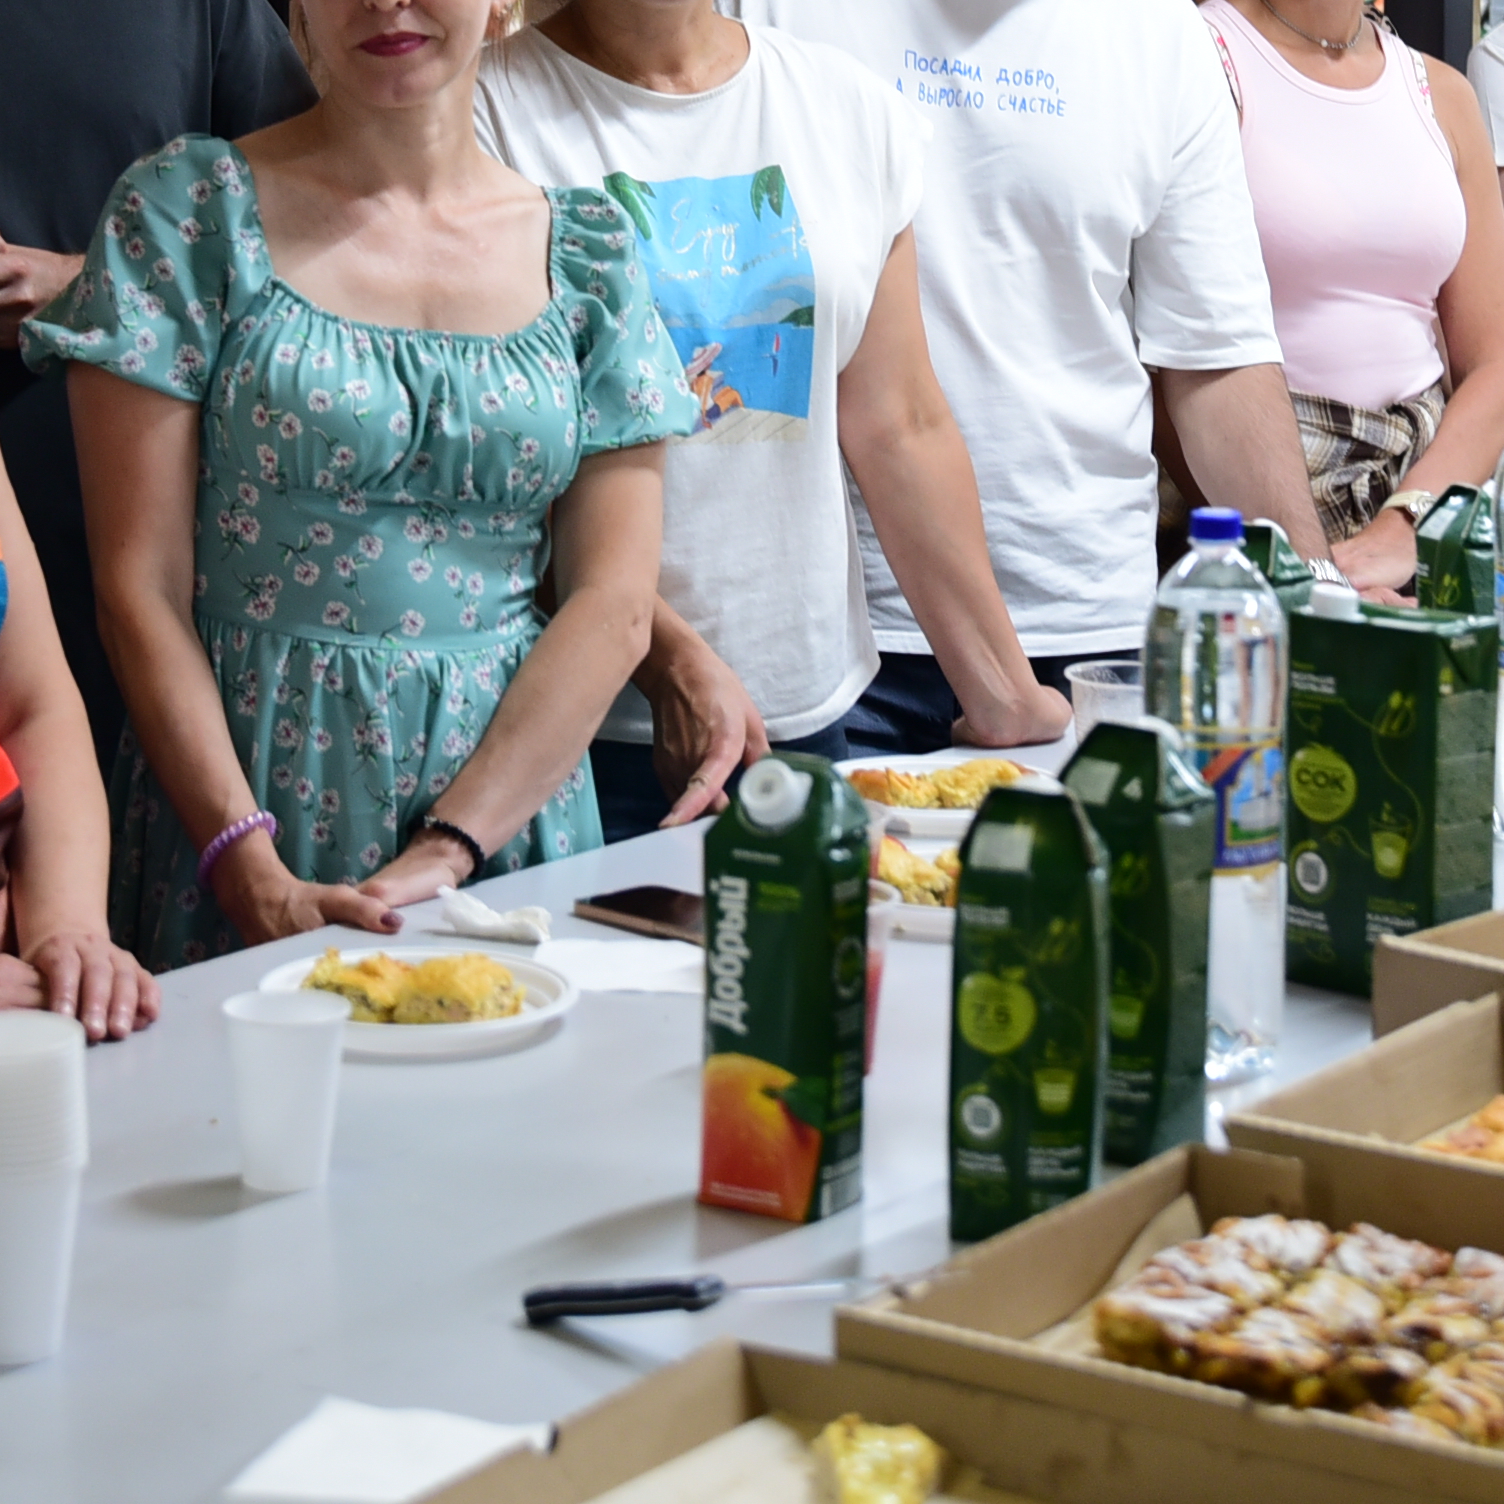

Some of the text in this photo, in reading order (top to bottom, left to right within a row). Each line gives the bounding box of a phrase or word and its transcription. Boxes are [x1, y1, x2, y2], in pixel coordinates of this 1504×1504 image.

[996, 67, 1061, 94] ДОБРО,
[918, 81, 984, 109] ВЫРОСЛО
[997, 93, 1067, 117] СЧАСТЬЕ
[1296, 767, 1347, 792] СОК
[709, 874, 750, 1035] Добрый
